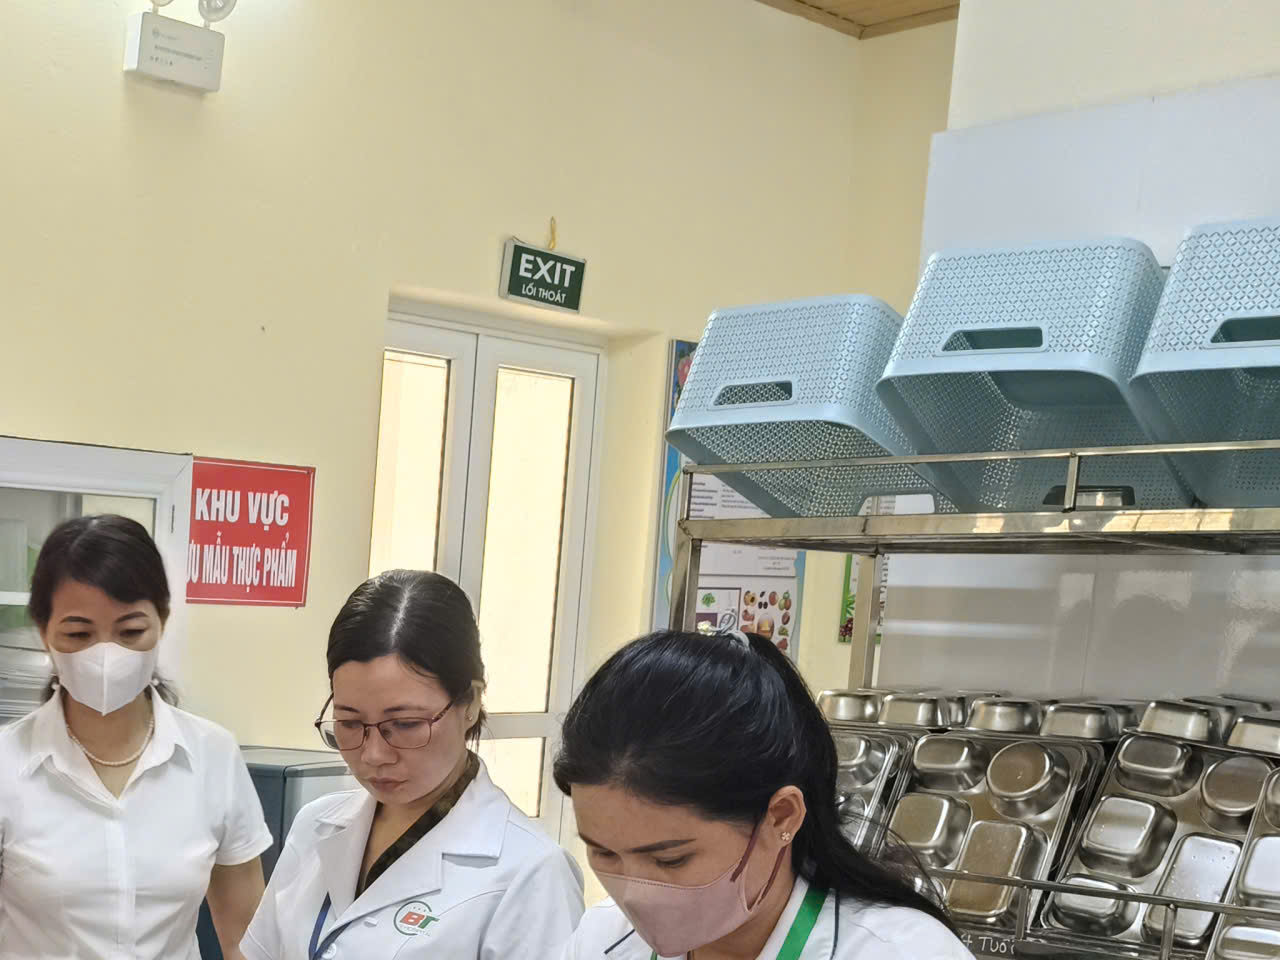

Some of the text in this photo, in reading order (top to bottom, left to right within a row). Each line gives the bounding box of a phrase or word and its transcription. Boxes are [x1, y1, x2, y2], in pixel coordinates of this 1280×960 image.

[519, 253, 575, 287] EXIT
[521, 282, 567, 304] LỐI THOÁT
[195, 488, 290, 531] KHU VỰC
[186, 530, 297, 593] ƯU MẪU THỰC PHẨM
